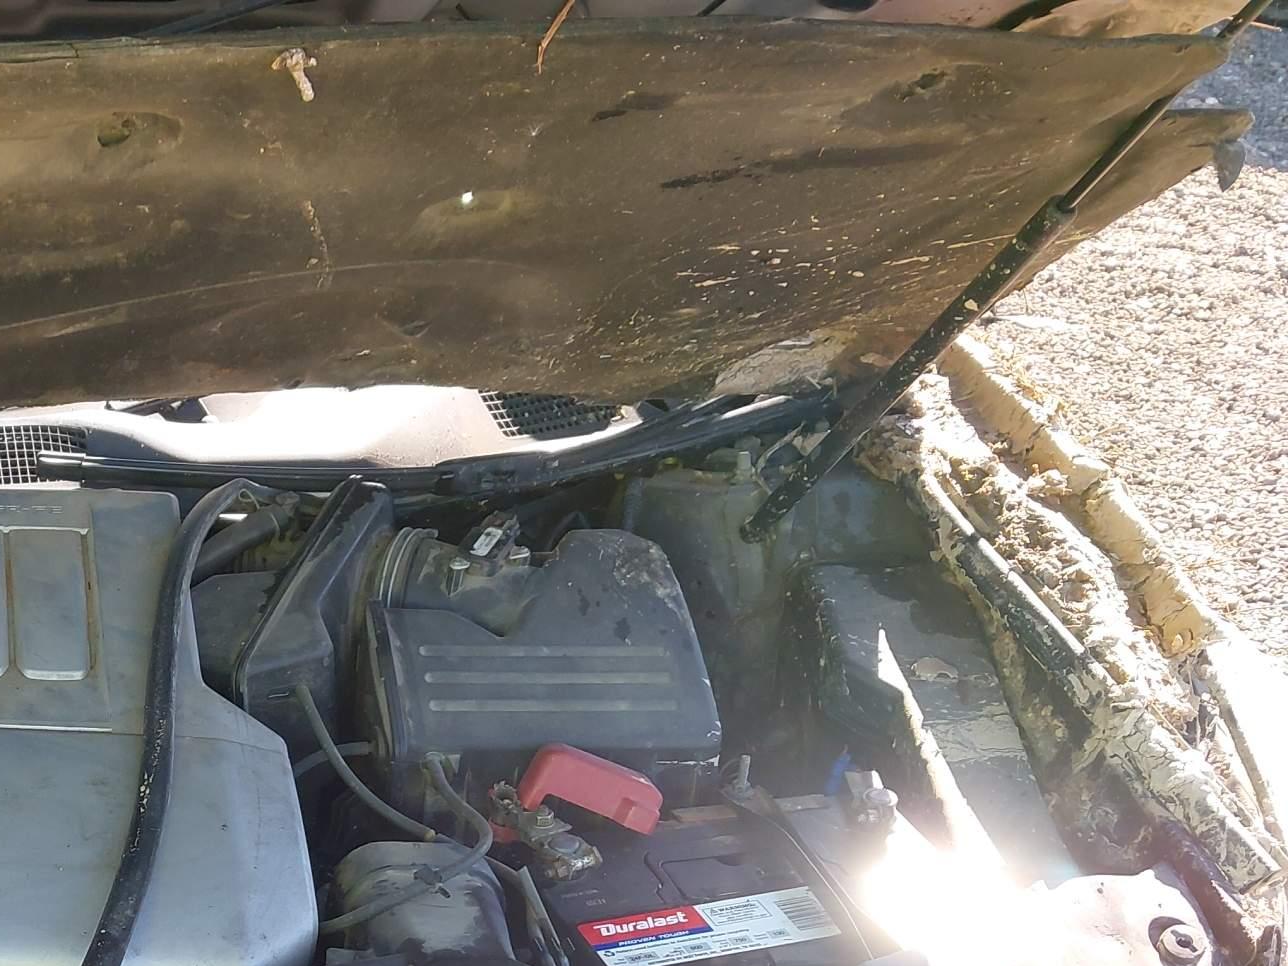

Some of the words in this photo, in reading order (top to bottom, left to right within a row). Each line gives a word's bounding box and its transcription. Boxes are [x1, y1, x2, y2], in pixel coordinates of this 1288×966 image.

[593, 911, 689, 936] Duralast
[618, 936, 656, 946] PROVEN
[659, 930, 690, 940] TOUGH
